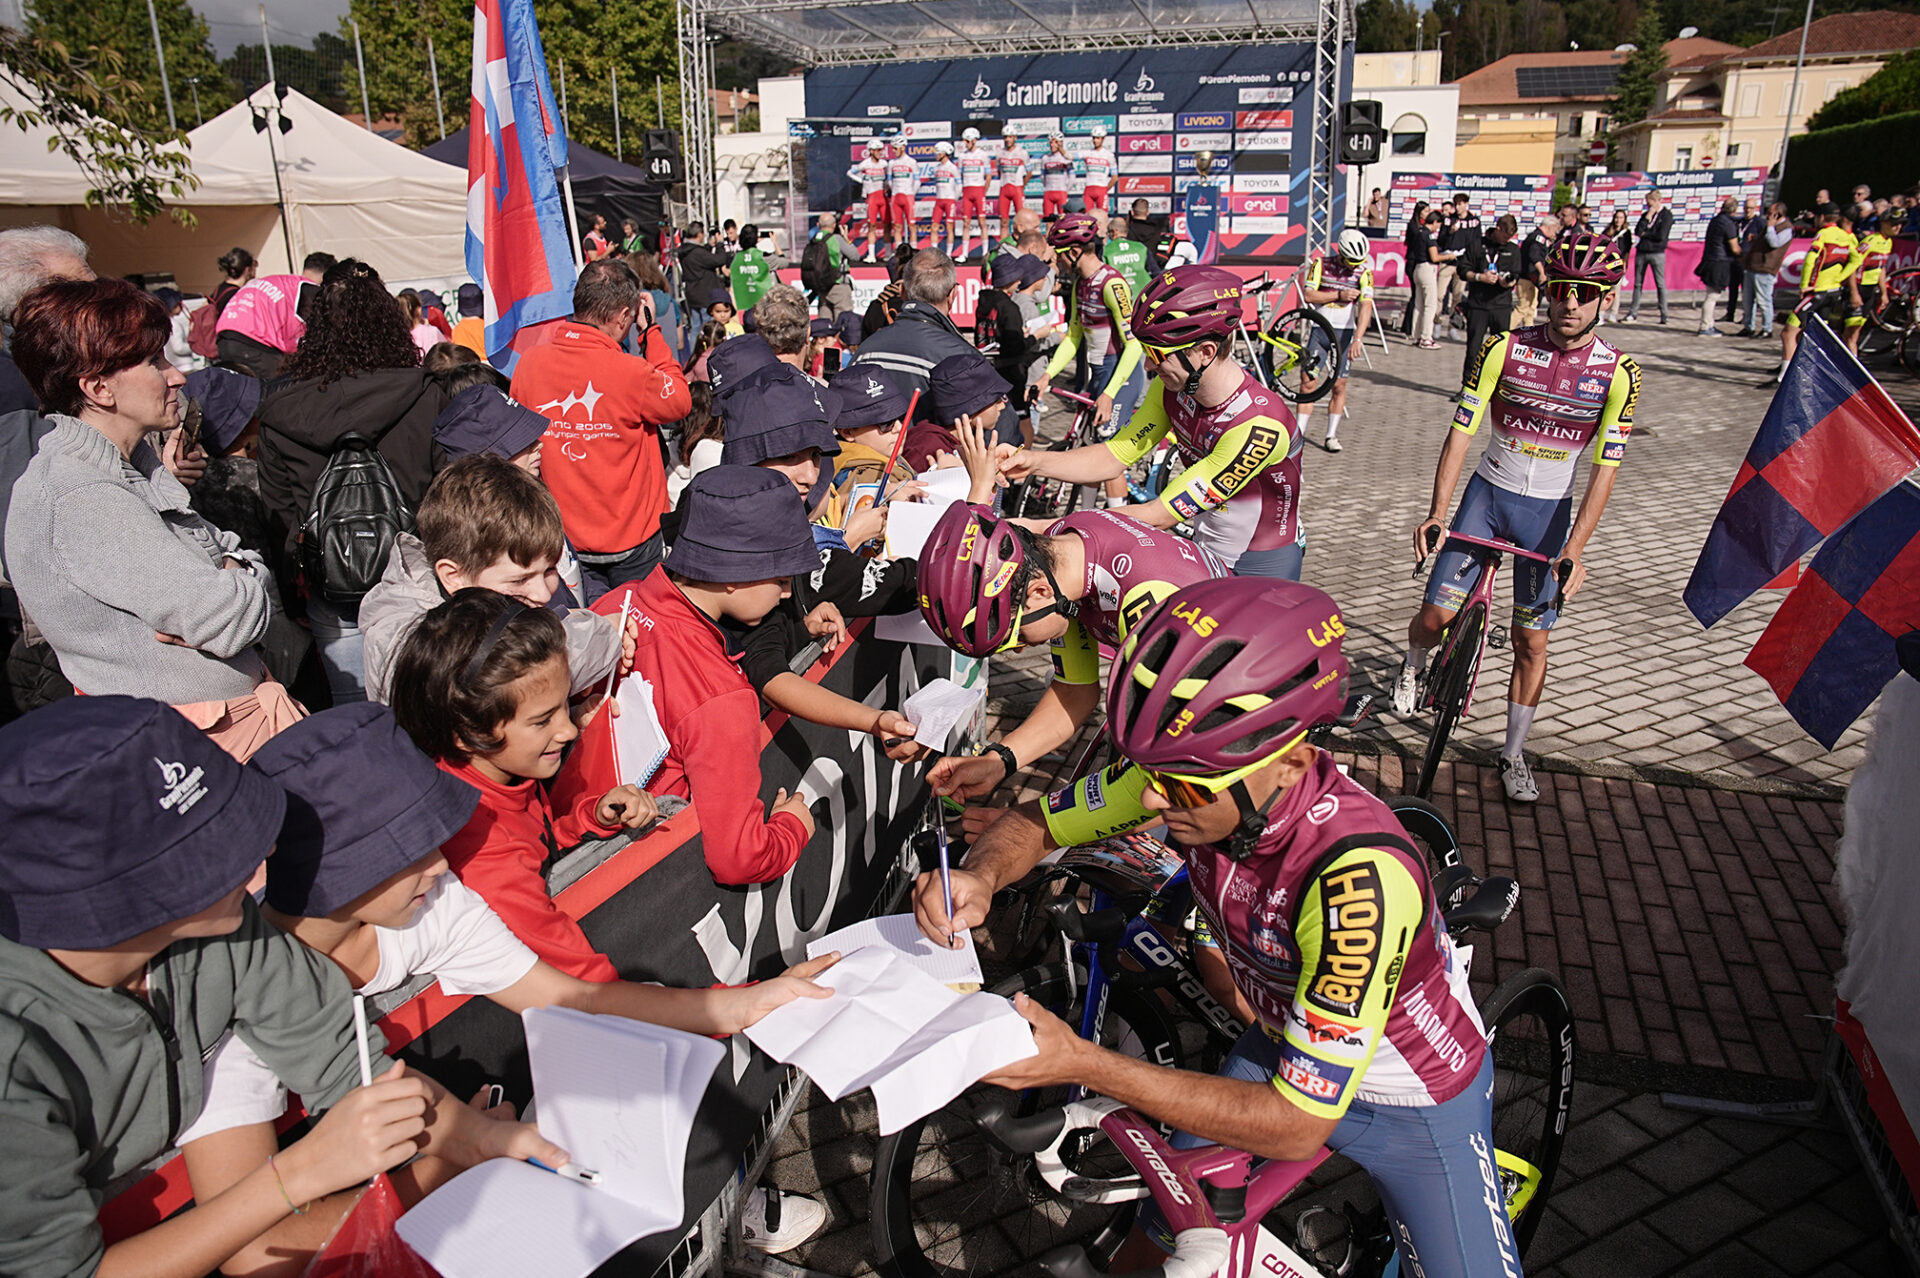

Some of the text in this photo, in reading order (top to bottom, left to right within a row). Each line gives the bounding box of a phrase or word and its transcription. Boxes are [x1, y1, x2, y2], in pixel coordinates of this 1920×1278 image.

[1006, 78, 1118, 107] GranPiemonte
[1128, 119, 1164, 127] TOYOTA
[1184, 116, 1225, 126] LIVIGNO
[1130, 138, 1161, 151] enel
[1244, 179, 1280, 188] TOYOTA
[1455, 174, 1508, 188] GranPiemonte
[1656, 172, 1714, 187] GranPiemonte
[1244, 198, 1277, 211] enel
[1113, 253, 1140, 265] PHOTO
[1213, 287, 1240, 300] LAS
[1274, 311, 1301, 332] URSUS
[1591, 369, 1613, 379] APRA
[1578, 383, 1605, 394] NERI
[1498, 389, 1601, 417] corratec
[575, 423, 613, 431] 2006
[1136, 421, 1157, 441] APRA
[1502, 413, 1583, 441] FANTINI
[1531, 416, 1557, 427] VINI
[1218, 428, 1277, 491] Hoppla
[957, 523, 979, 561] LAS
[1529, 566, 1537, 601] URSUS
[1100, 588, 1118, 605] velo
[1171, 601, 1219, 638] LAS
[1306, 614, 1348, 648] LAS
[1166, 708, 1195, 738] LAS
[1109, 813, 1151, 834] APRA
[1316, 867, 1381, 1004] Hoppla
[1252, 931, 1293, 962] NERI
[1133, 930, 1245, 1041] corratec
[1279, 1059, 1338, 1097] NERI
[1558, 1023, 1573, 1136] URSUS
[1125, 1128, 1192, 1205] corratec
